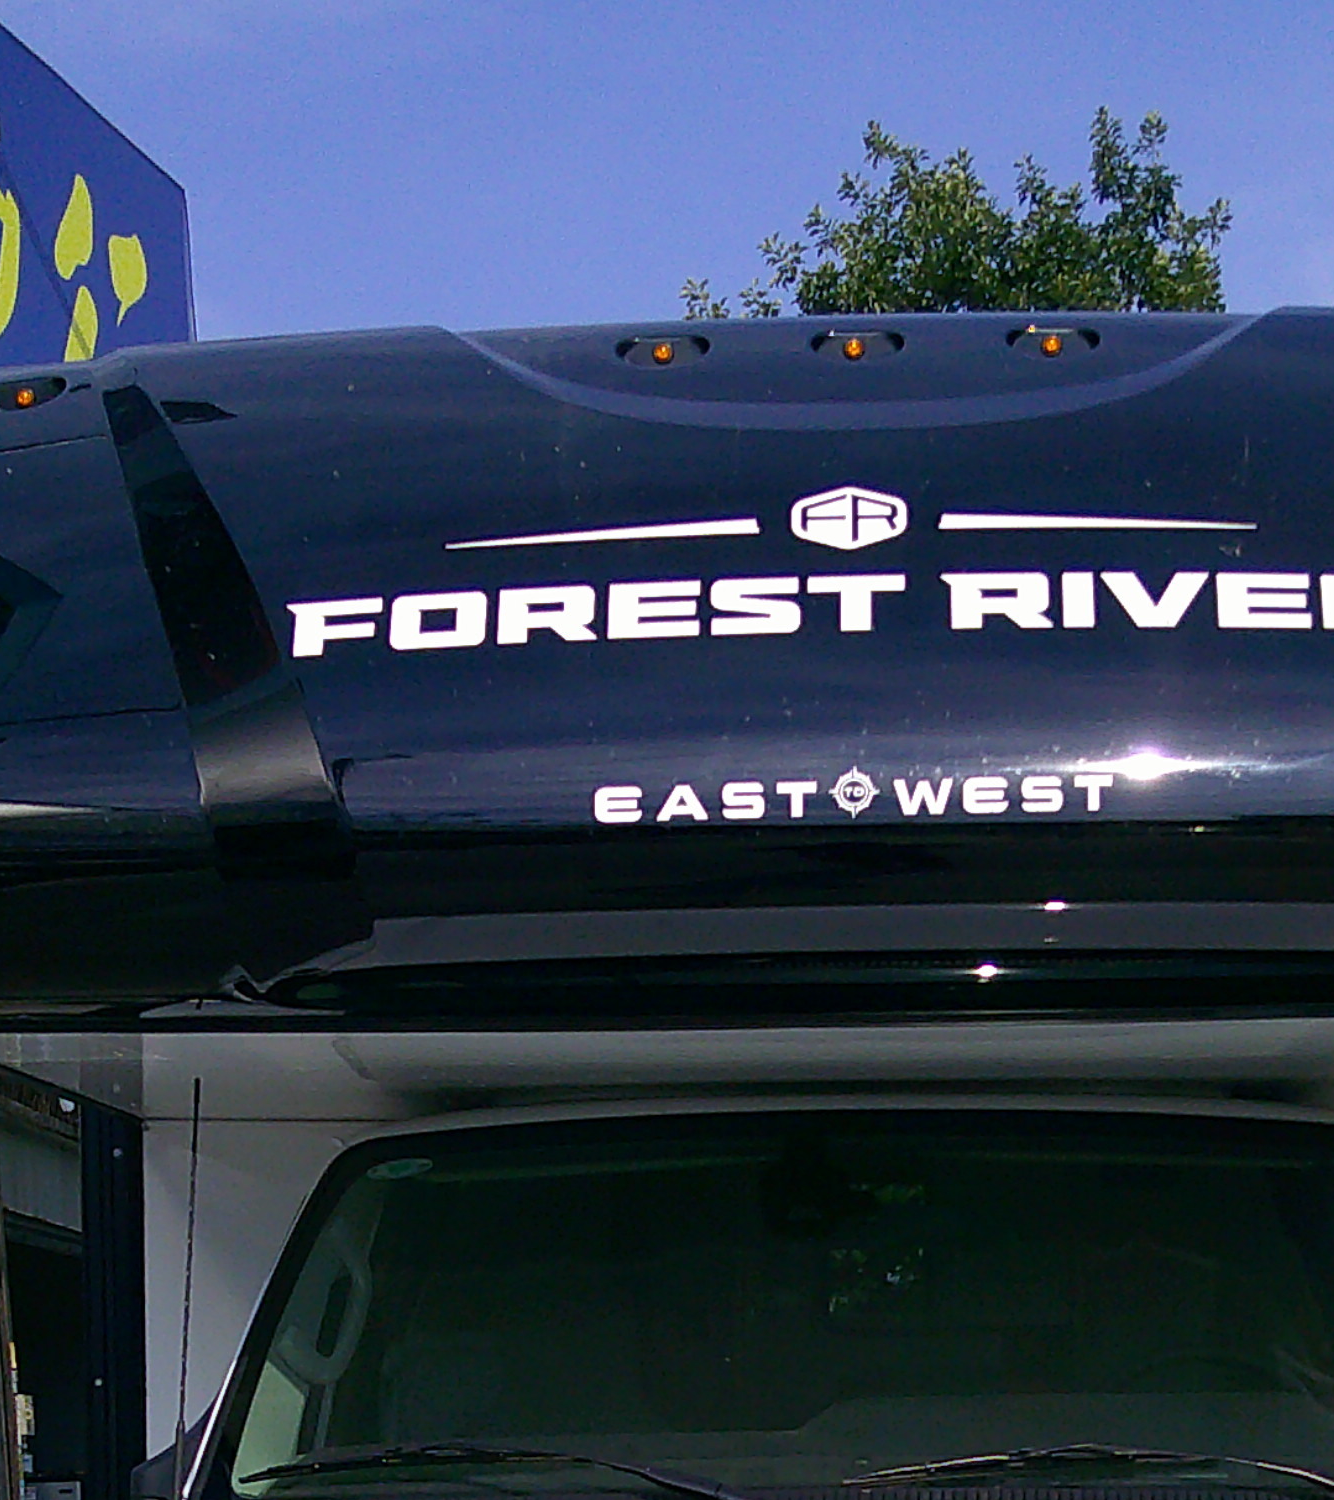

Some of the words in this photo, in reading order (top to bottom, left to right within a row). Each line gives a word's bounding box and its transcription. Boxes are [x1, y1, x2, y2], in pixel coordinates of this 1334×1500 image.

[285, 572, 907, 658] FOREST
[593, 779, 819, 824] EAST
[892, 773, 1115, 817] WEST
